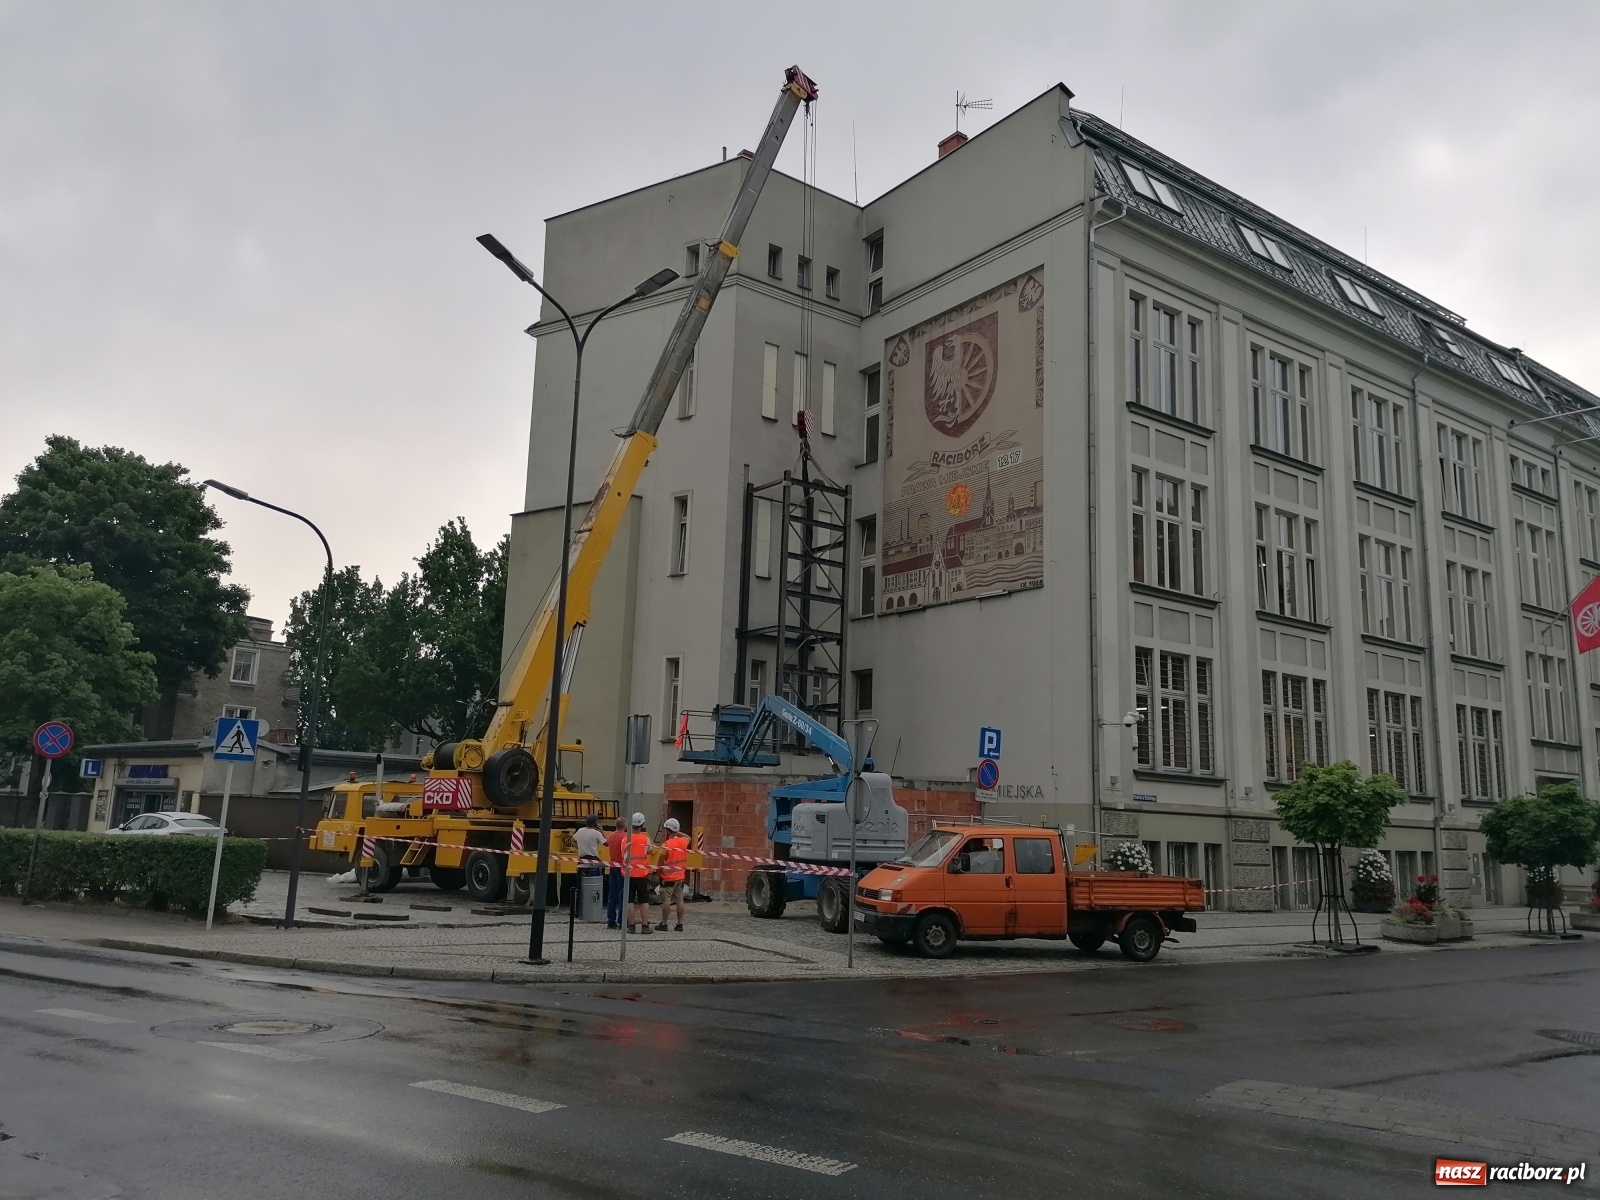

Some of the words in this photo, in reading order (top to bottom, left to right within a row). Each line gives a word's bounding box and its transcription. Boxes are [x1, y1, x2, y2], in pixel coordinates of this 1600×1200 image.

[998, 451, 1020, 467] 1217
[901, 478, 937, 497] PRAWA
[939, 460, 990, 485] MIEJSKIE
[983, 731, 997, 755] P
[87, 762, 97, 775] L
[424, 791, 453, 805] CKD
